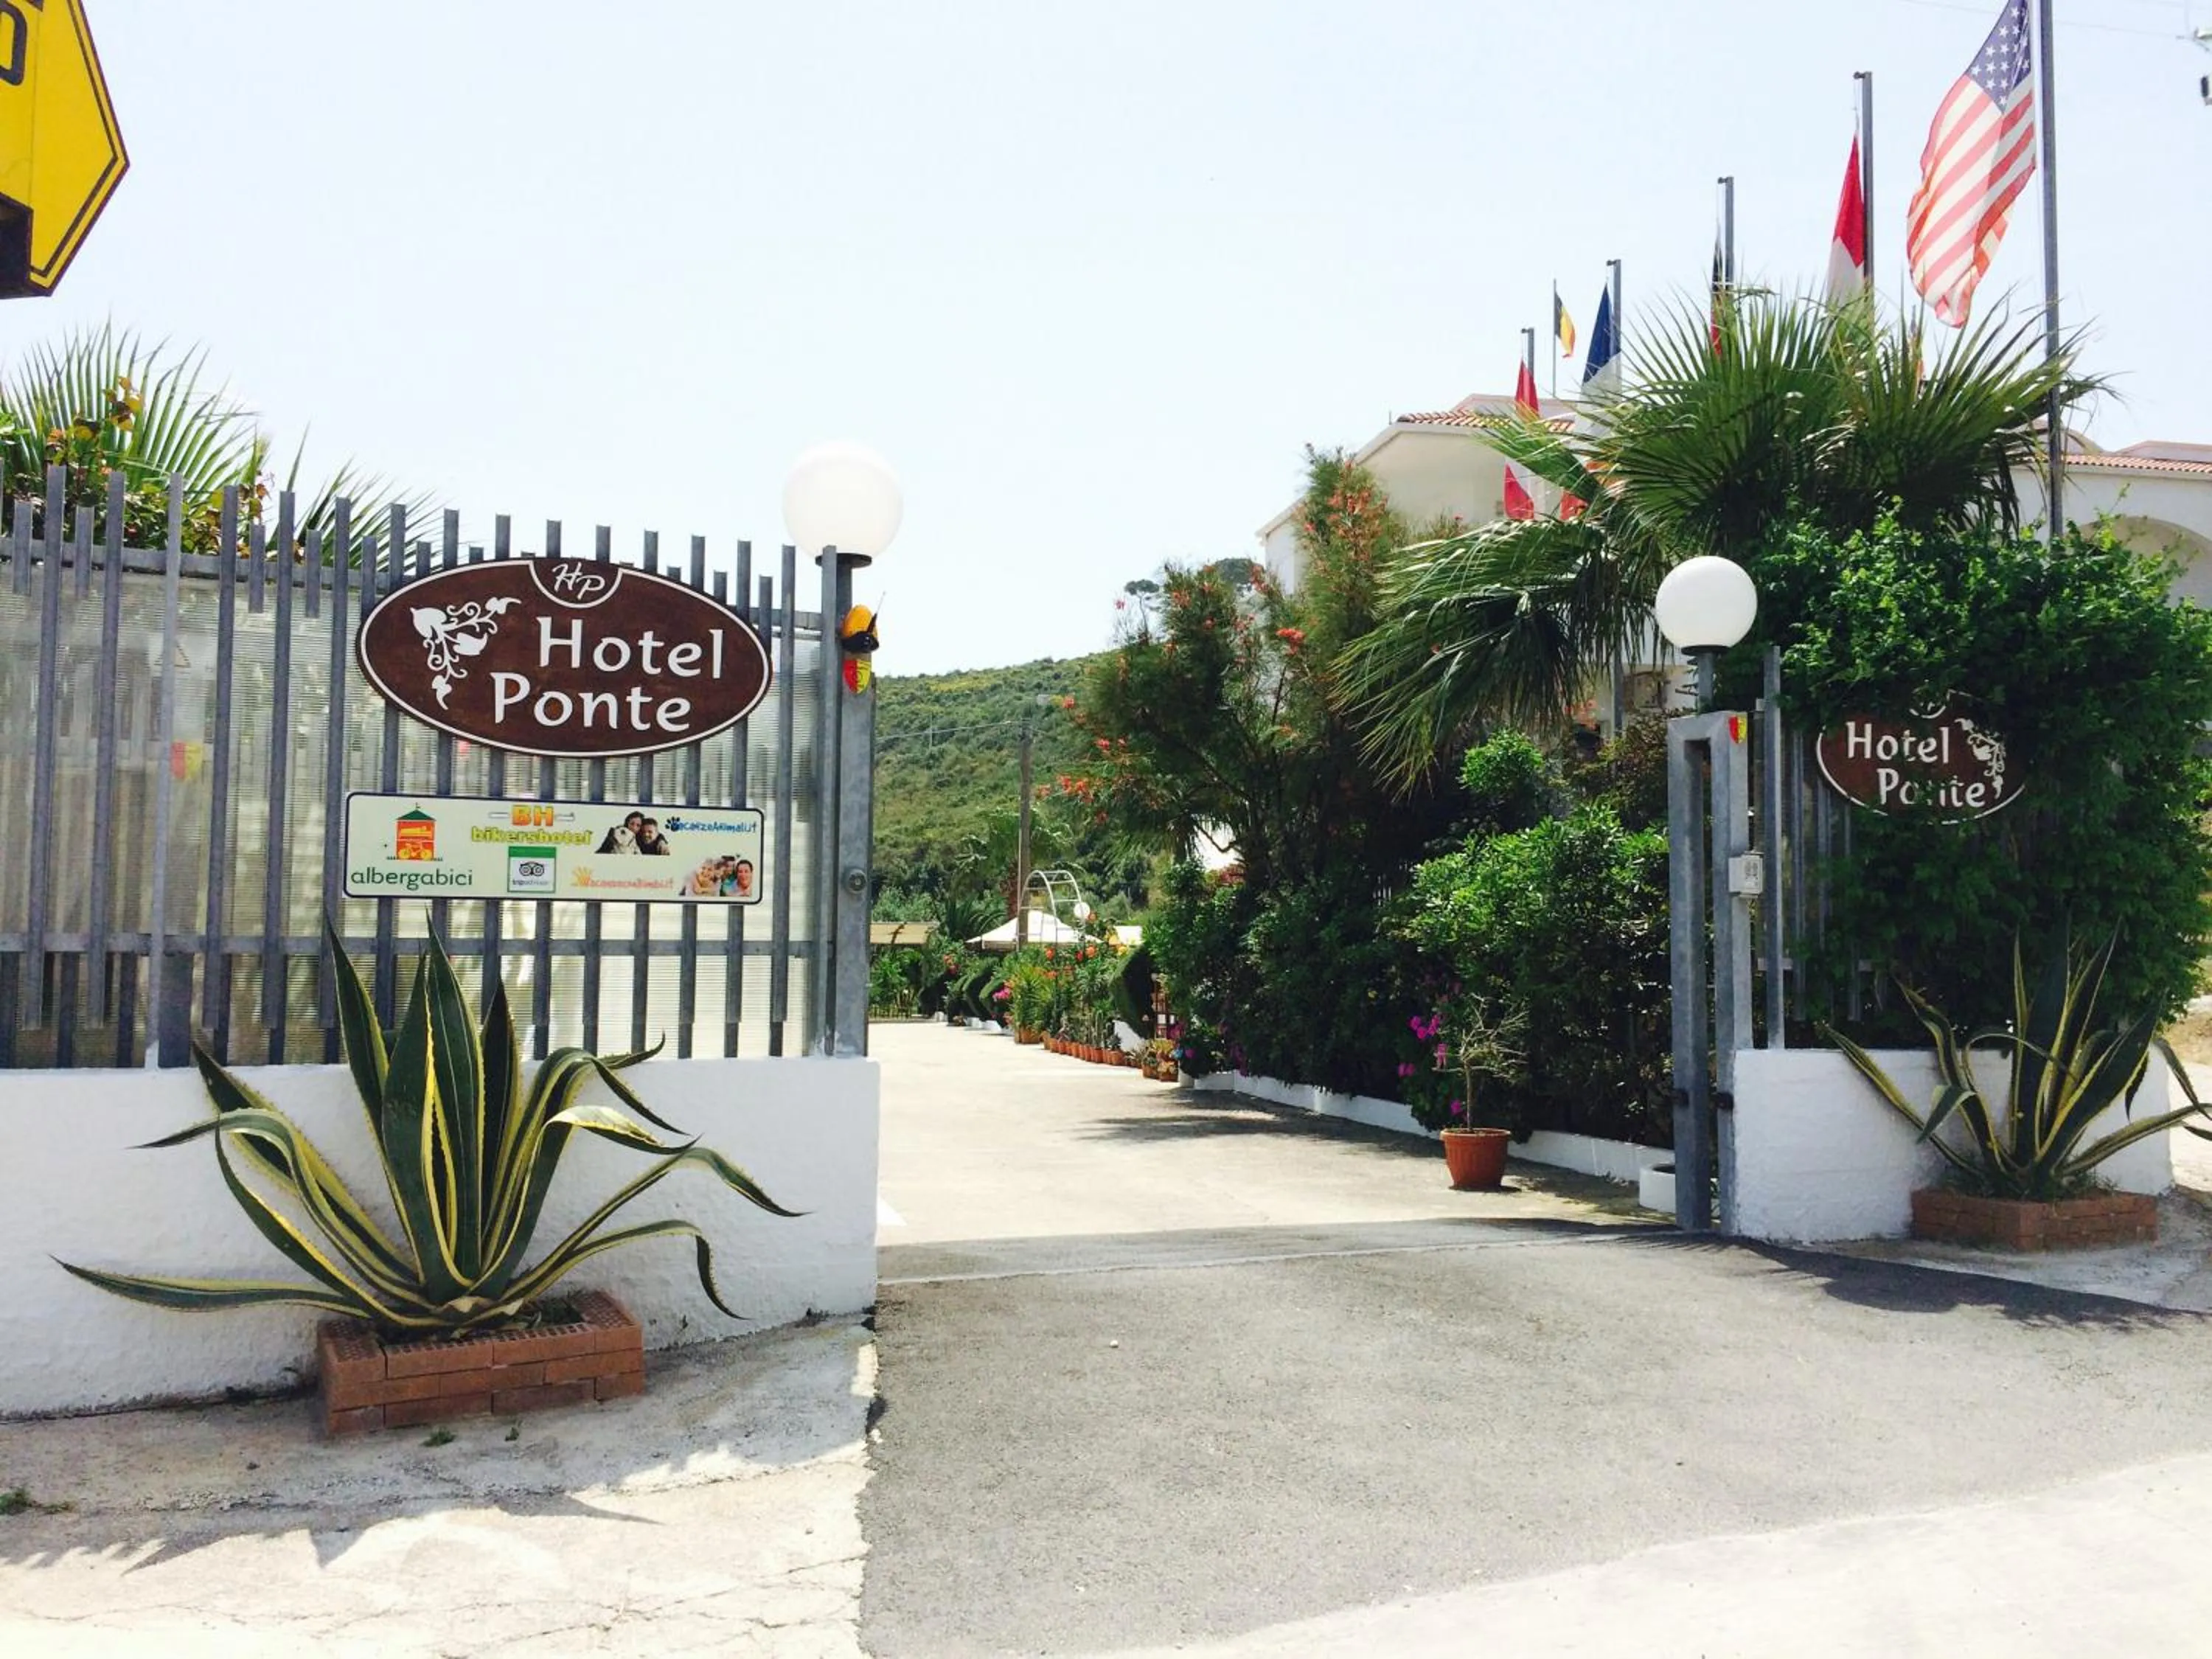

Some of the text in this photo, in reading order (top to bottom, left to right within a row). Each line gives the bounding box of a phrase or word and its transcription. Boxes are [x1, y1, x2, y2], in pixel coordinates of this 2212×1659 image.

[552, 563, 605, 600] HP
[536, 616, 723, 679] Hotel
[490, 672, 691, 732] Ponte
[1846, 721, 1949, 764] Hotel
[511, 804, 554, 827] BH
[471, 825, 591, 845] bikershotel
[350, 867, 473, 891] albergabici
